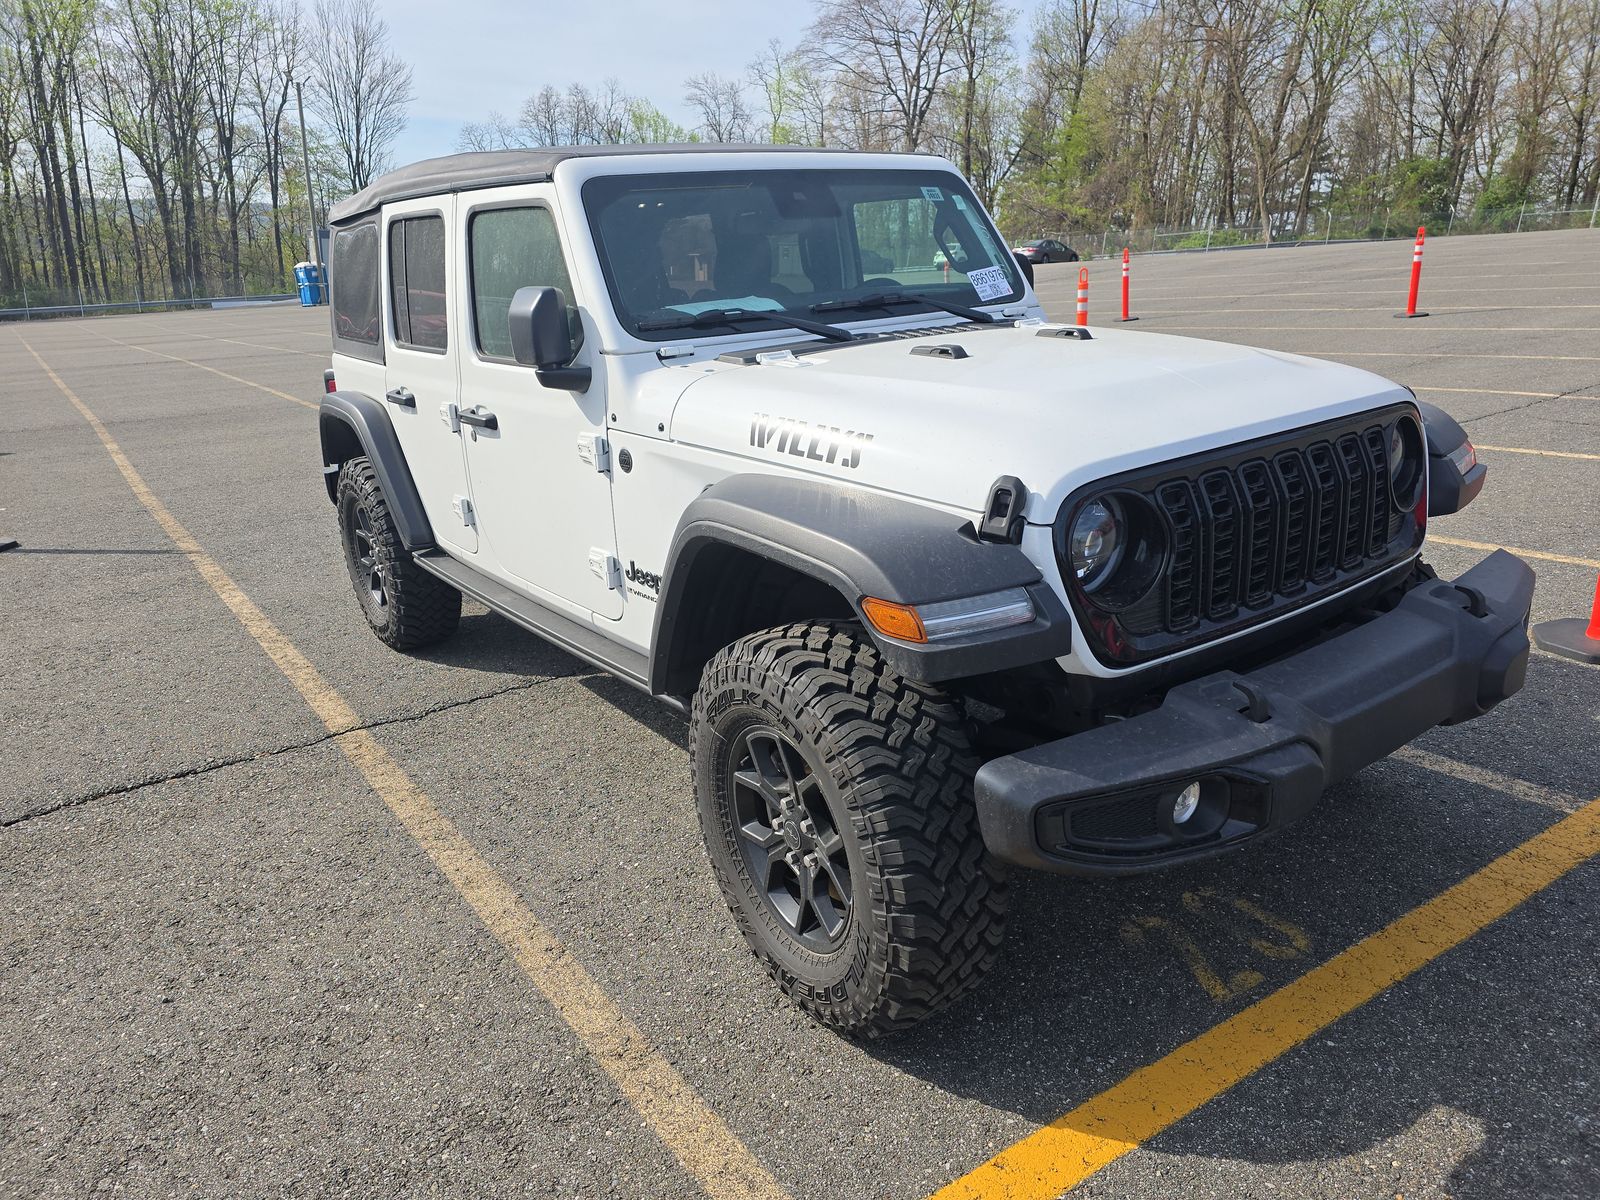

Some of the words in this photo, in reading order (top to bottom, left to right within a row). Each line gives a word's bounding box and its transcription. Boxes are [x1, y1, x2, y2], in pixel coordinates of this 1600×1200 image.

[970, 269, 1005, 286] 8661976
[750, 412, 874, 469] WILLYS
[761, 921, 870, 1005] WILDPEAK
